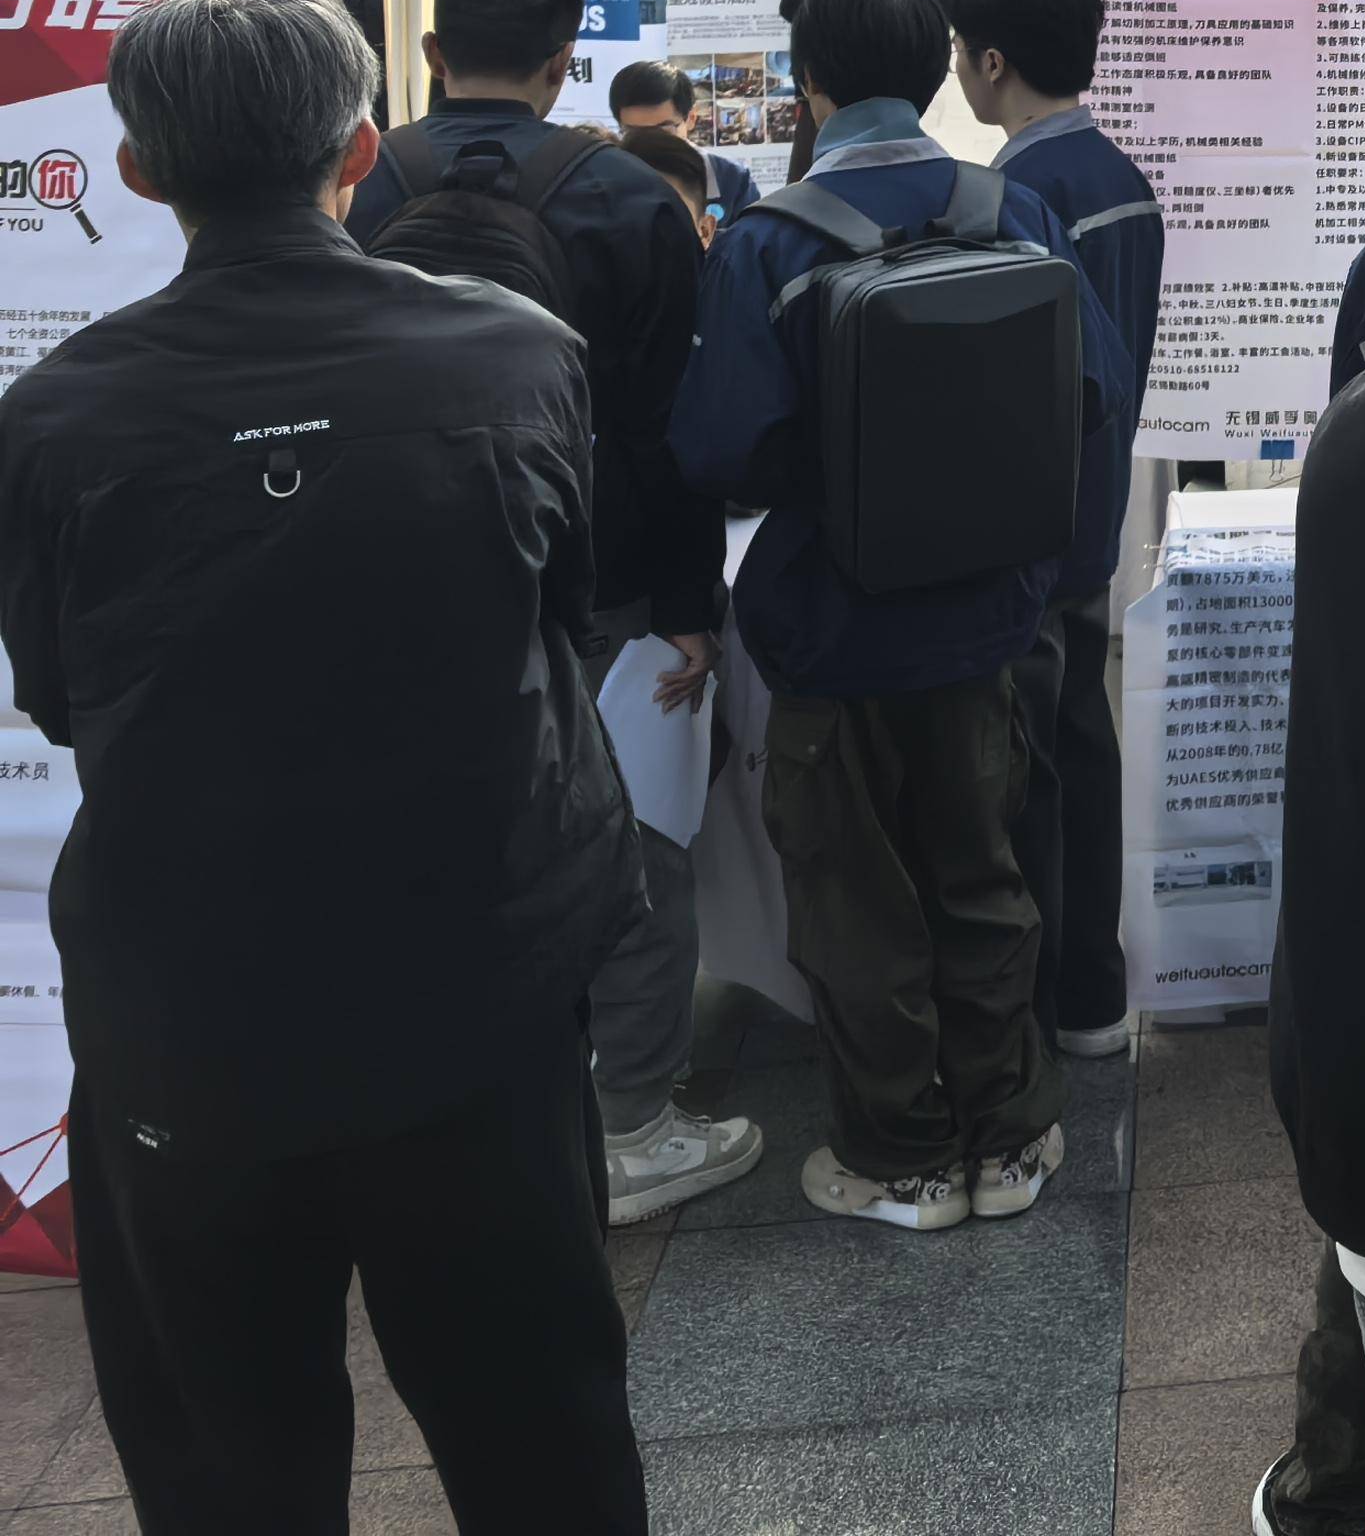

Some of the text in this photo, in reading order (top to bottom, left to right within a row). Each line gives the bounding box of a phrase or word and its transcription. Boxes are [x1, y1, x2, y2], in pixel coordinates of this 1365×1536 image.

[8, 218, 44, 232] YOU
[233, 419, 330, 442] ASK FOR MORE
[1225, 429, 1254, 438] Wuxi
